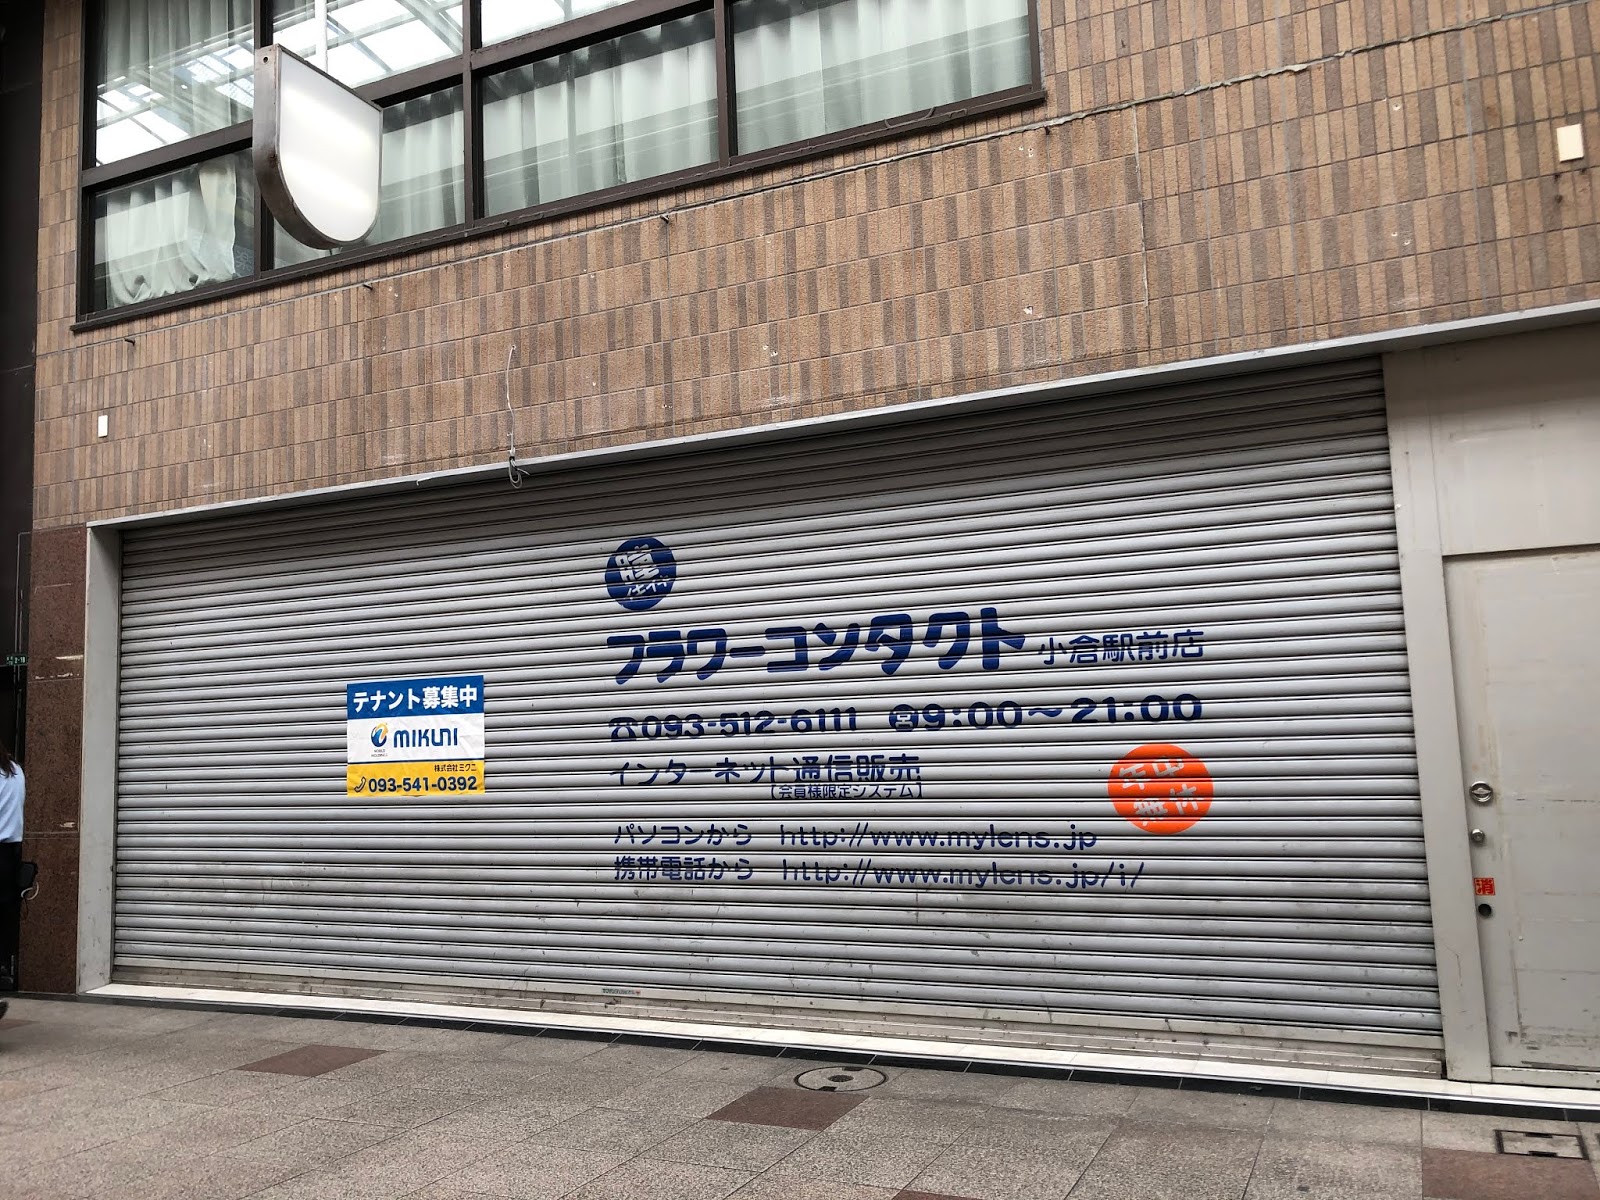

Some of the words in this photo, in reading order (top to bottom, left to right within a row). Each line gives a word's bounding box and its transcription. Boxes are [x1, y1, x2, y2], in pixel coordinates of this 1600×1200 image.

[606, 606, 1026, 685] フラワーコンタクト
[1037, 628, 1206, 666] 小倉駅前店
[352, 684, 478, 713] テナント募集中
[641, 706, 858, 740] 093-512-6111
[368, 776, 478, 793] 093-541-0392
[609, 752, 921, 786] インターネット通信販売
[614, 823, 752, 846] パソコンから
[780, 822, 1097, 851] http://www.mylens.jp
[613, 855, 754, 881] 携帯電話から
[782, 857, 1145, 889] http://www.mylens.jp/i/
